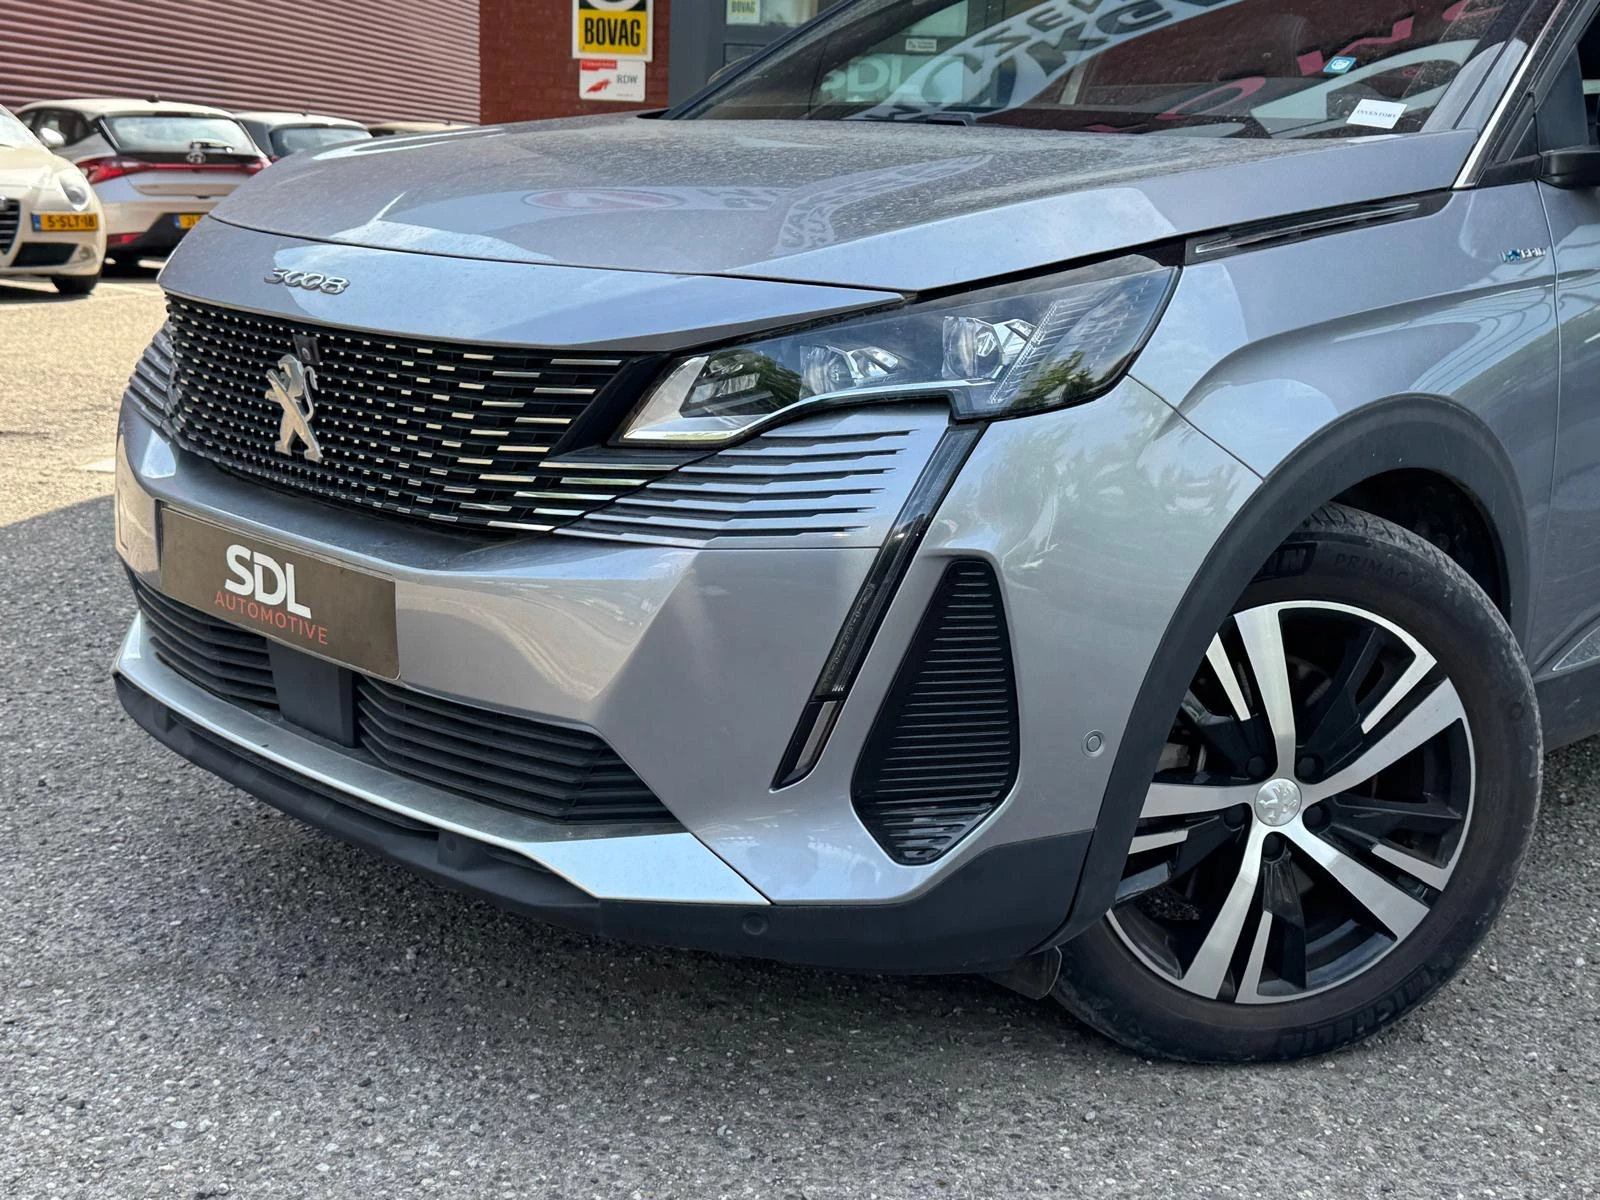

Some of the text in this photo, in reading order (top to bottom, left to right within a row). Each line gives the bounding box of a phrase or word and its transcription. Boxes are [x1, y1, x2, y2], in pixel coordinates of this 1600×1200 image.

[583, 16, 642, 47] BOVAG
[616, 75, 638, 84] RDW
[263, 267, 351, 295] 3008
[224, 544, 312, 619] SDL
[213, 590, 330, 646] AUTOMOTIVE
